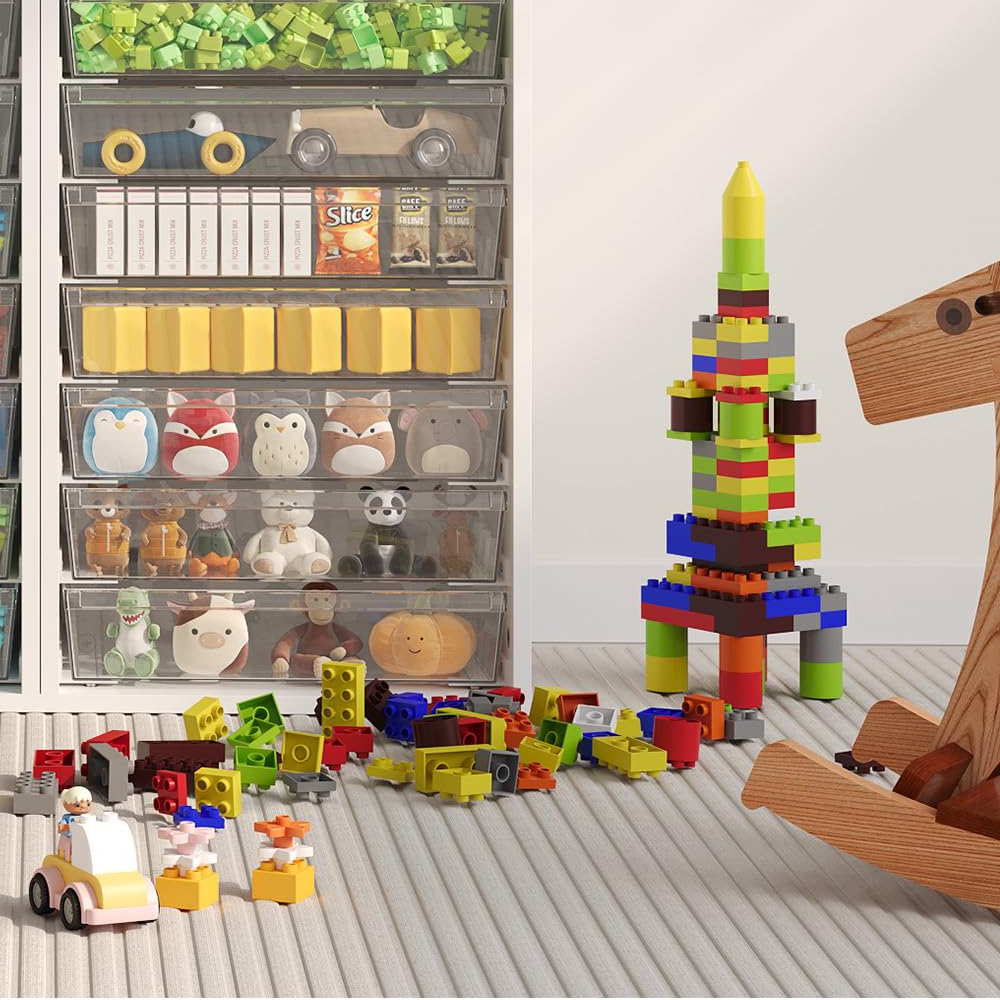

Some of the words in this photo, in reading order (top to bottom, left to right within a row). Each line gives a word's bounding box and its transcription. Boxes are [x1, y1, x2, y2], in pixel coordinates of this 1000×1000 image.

[325, 206, 374, 227] Slice
[169, 246, 177, 260] PIZZA
[231, 246, 239, 260] PIZZA
